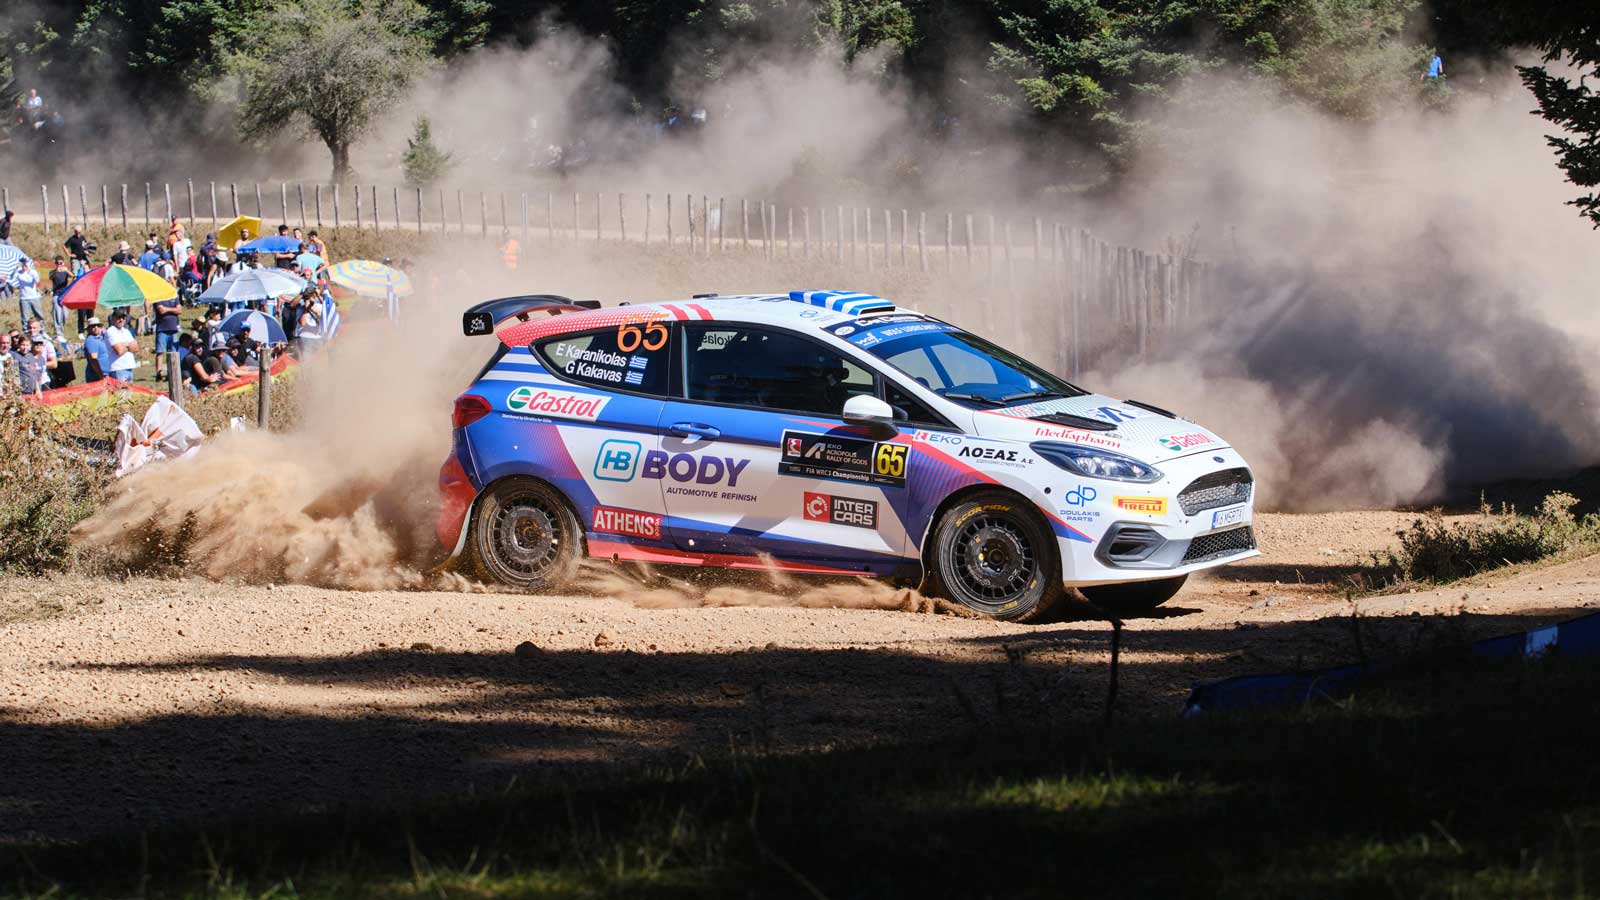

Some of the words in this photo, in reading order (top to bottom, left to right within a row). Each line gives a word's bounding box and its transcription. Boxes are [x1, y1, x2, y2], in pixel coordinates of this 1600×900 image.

[617, 313, 669, 353] 65
[555, 343, 567, 356] E
[565, 344, 627, 367] Karanikolas
[565, 360, 577, 374] G
[576, 361, 623, 383] Kakavas
[528, 391, 602, 417] Castrol
[929, 434, 962, 445] EKO
[602, 450, 632, 471] HB
[826, 449, 857, 458] ACROPOLIS
[826, 455, 843, 463] RALLY
[877, 444, 906, 477] 65
[958, 446, 1023, 462] ΛΟΞΑΣ
[641, 449, 752, 487] BODY
[832, 470, 870, 483] Championship
[666, 487, 718, 499] AUTOMOTIVE
[721, 492, 757, 502] REFINISH
[833, 498, 874, 515] INTER
[1060, 509, 1101, 517] DOULAKIS
[1118, 498, 1163, 511] PIRELLI
[593, 509, 655, 536] ATHENS
[833, 510, 874, 527] CARS
